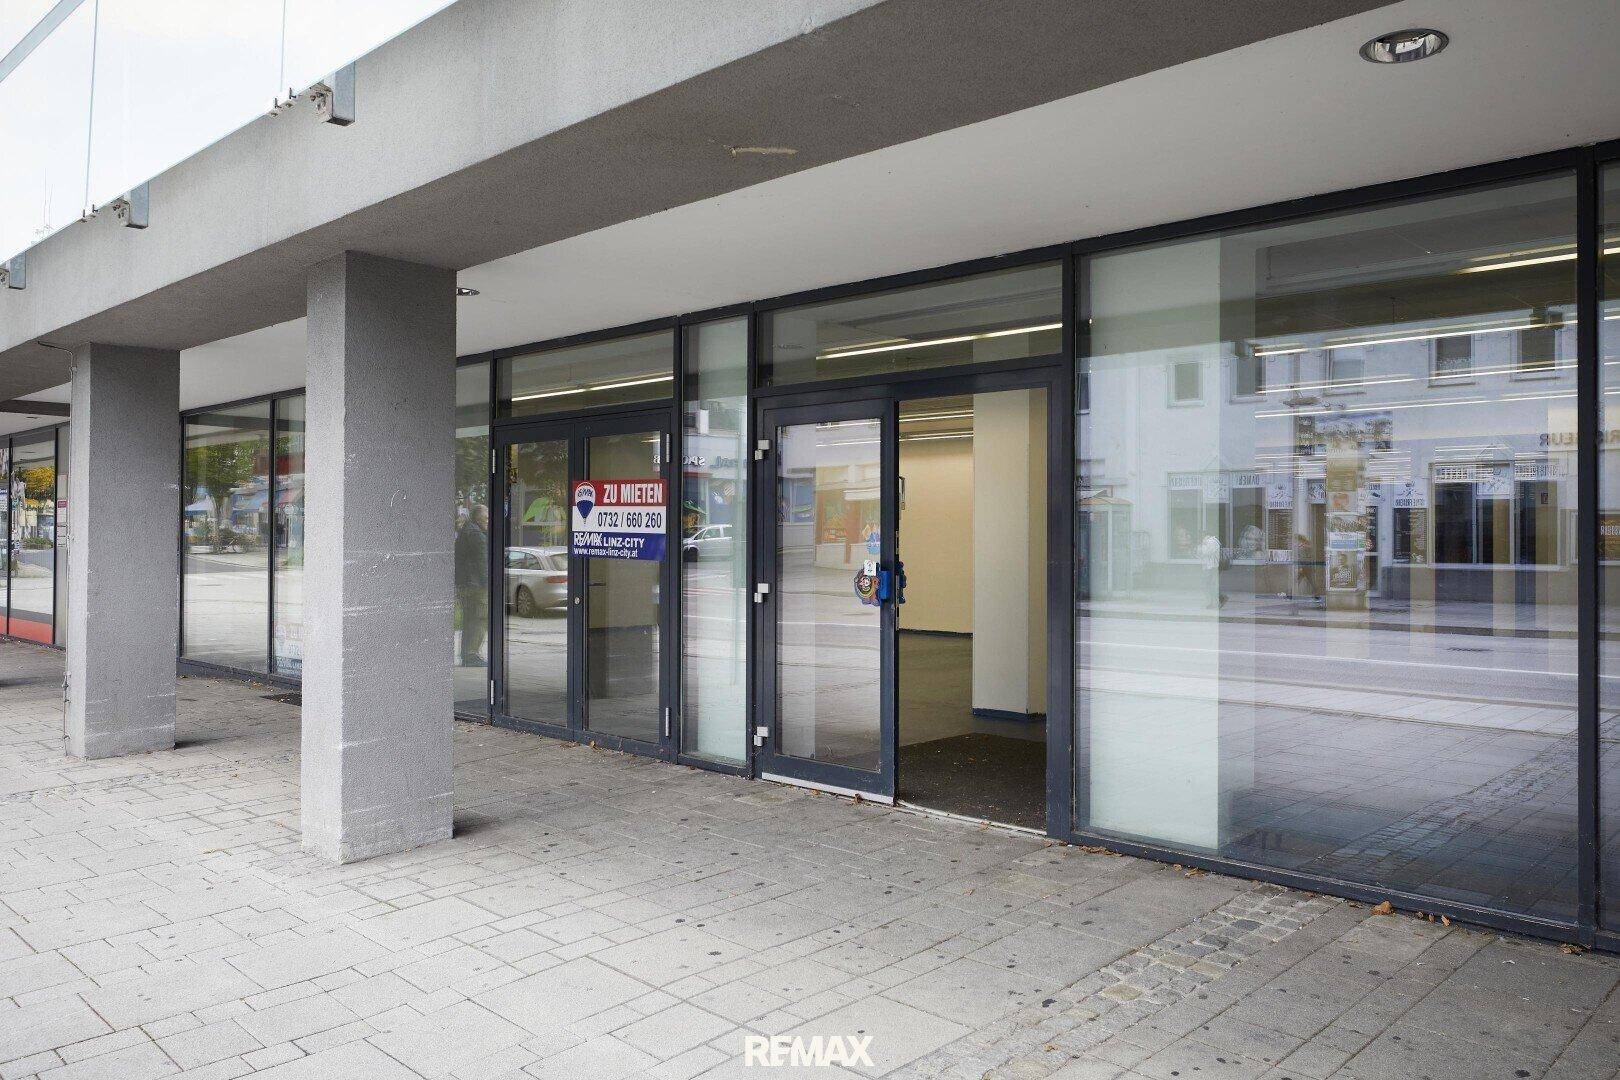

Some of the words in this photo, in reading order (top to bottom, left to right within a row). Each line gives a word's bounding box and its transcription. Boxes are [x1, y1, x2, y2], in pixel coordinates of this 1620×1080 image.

[603, 484, 618, 504] ZU
[620, 483, 663, 504] MIETEN
[597, 512, 619, 528] 0732
[620, 512, 625, 528] /
[626, 512, 643, 528] 660
[645, 512, 662, 528] 260
[603, 536, 645, 548] LINZ-CITY
[573, 547, 638, 559] www.remax-linz-city.at
